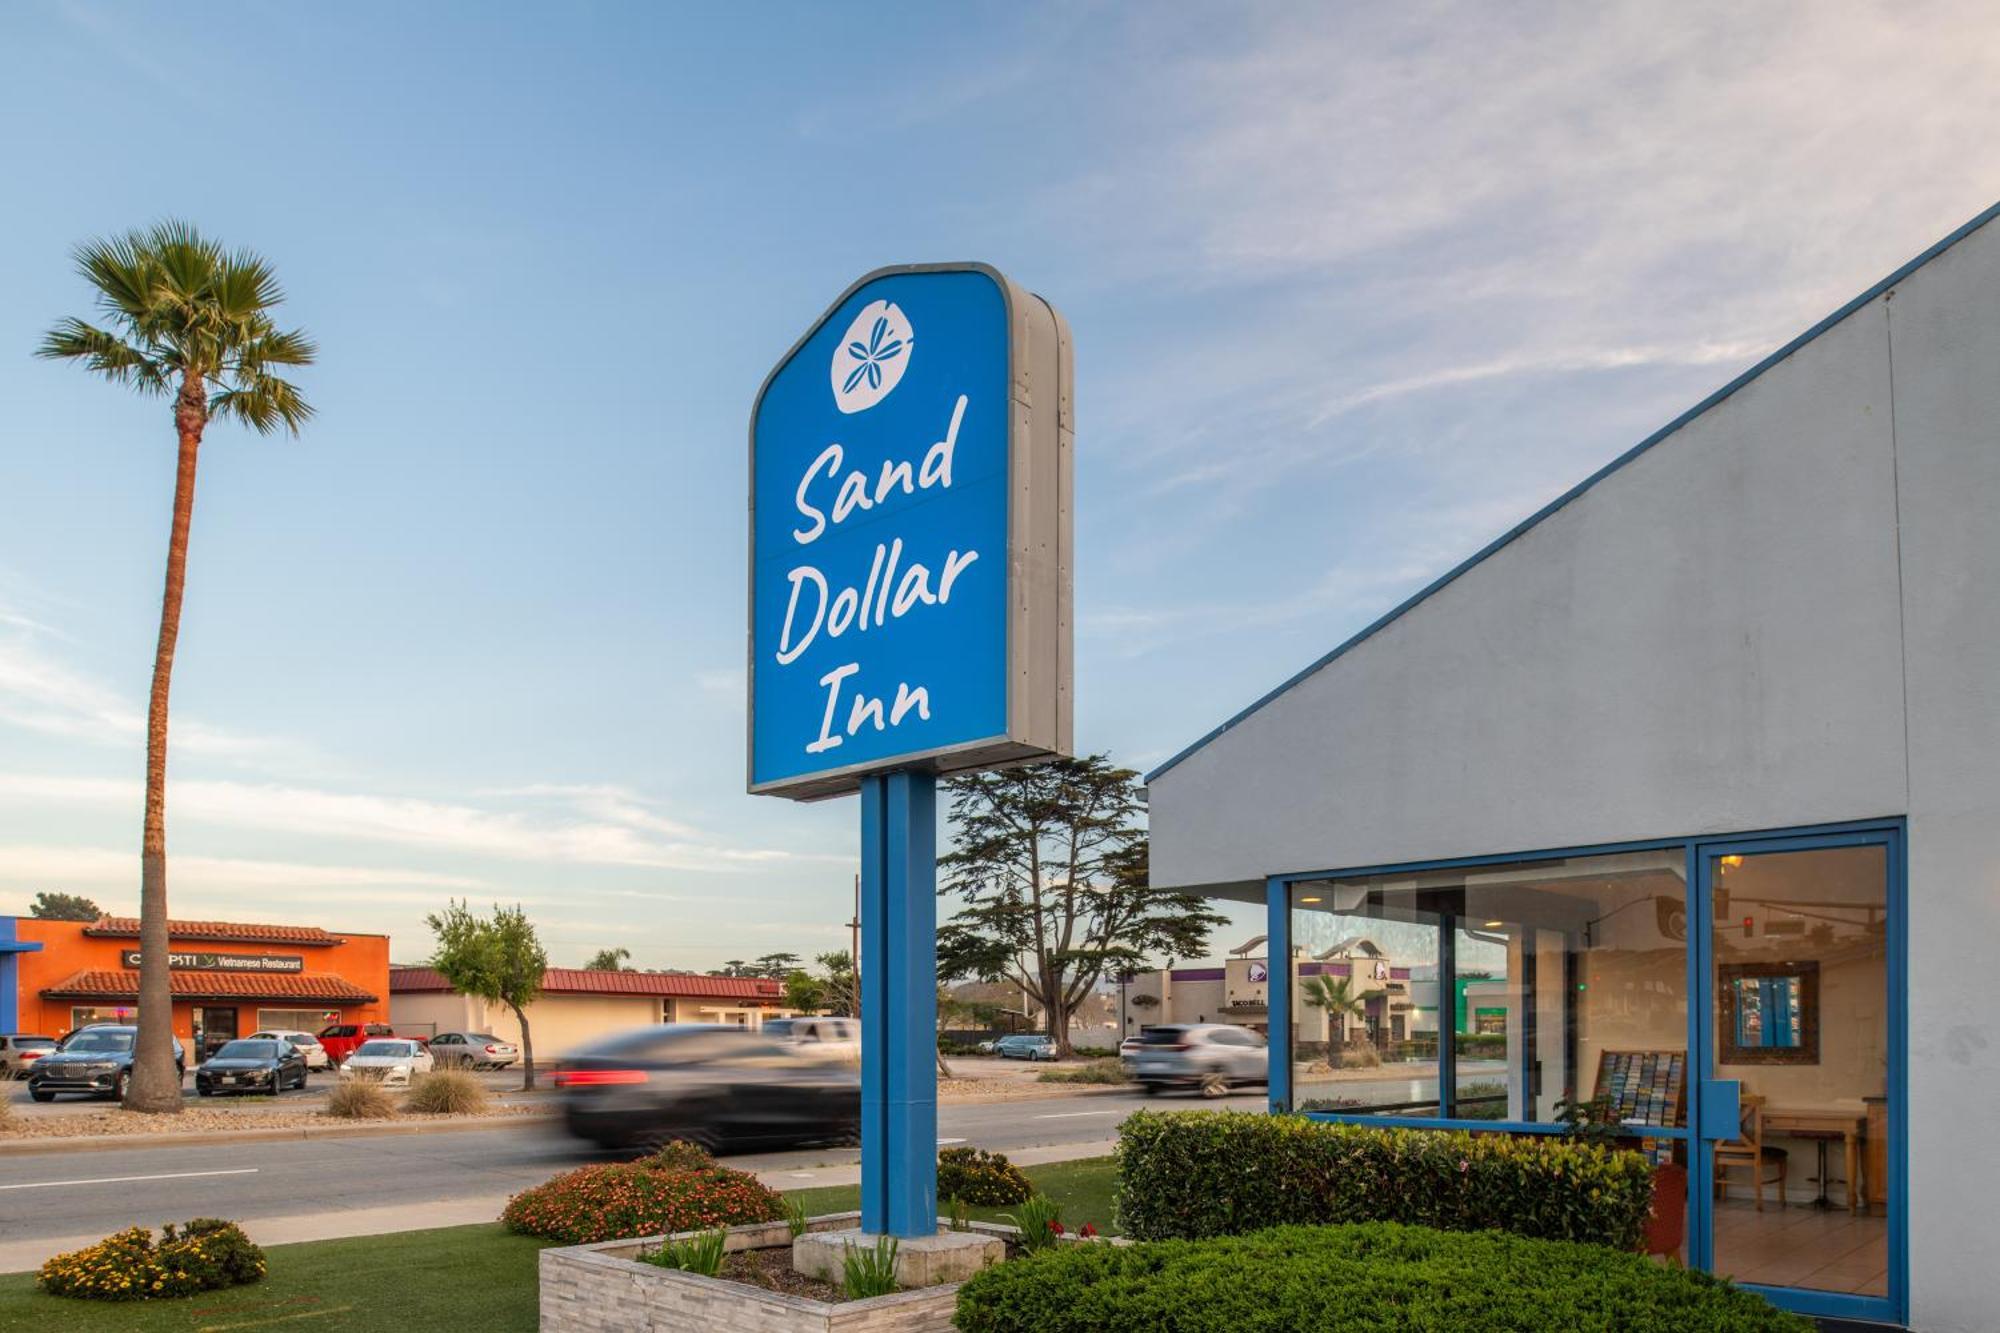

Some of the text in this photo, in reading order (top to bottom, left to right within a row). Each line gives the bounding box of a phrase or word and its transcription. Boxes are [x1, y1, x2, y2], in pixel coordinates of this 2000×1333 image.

[793, 395, 968, 545] Sand
[776, 538, 979, 665] Dollar
[806, 662, 931, 754] Inn
[128, 953, 301, 969] CPSTI Vietnamese Restaurant
